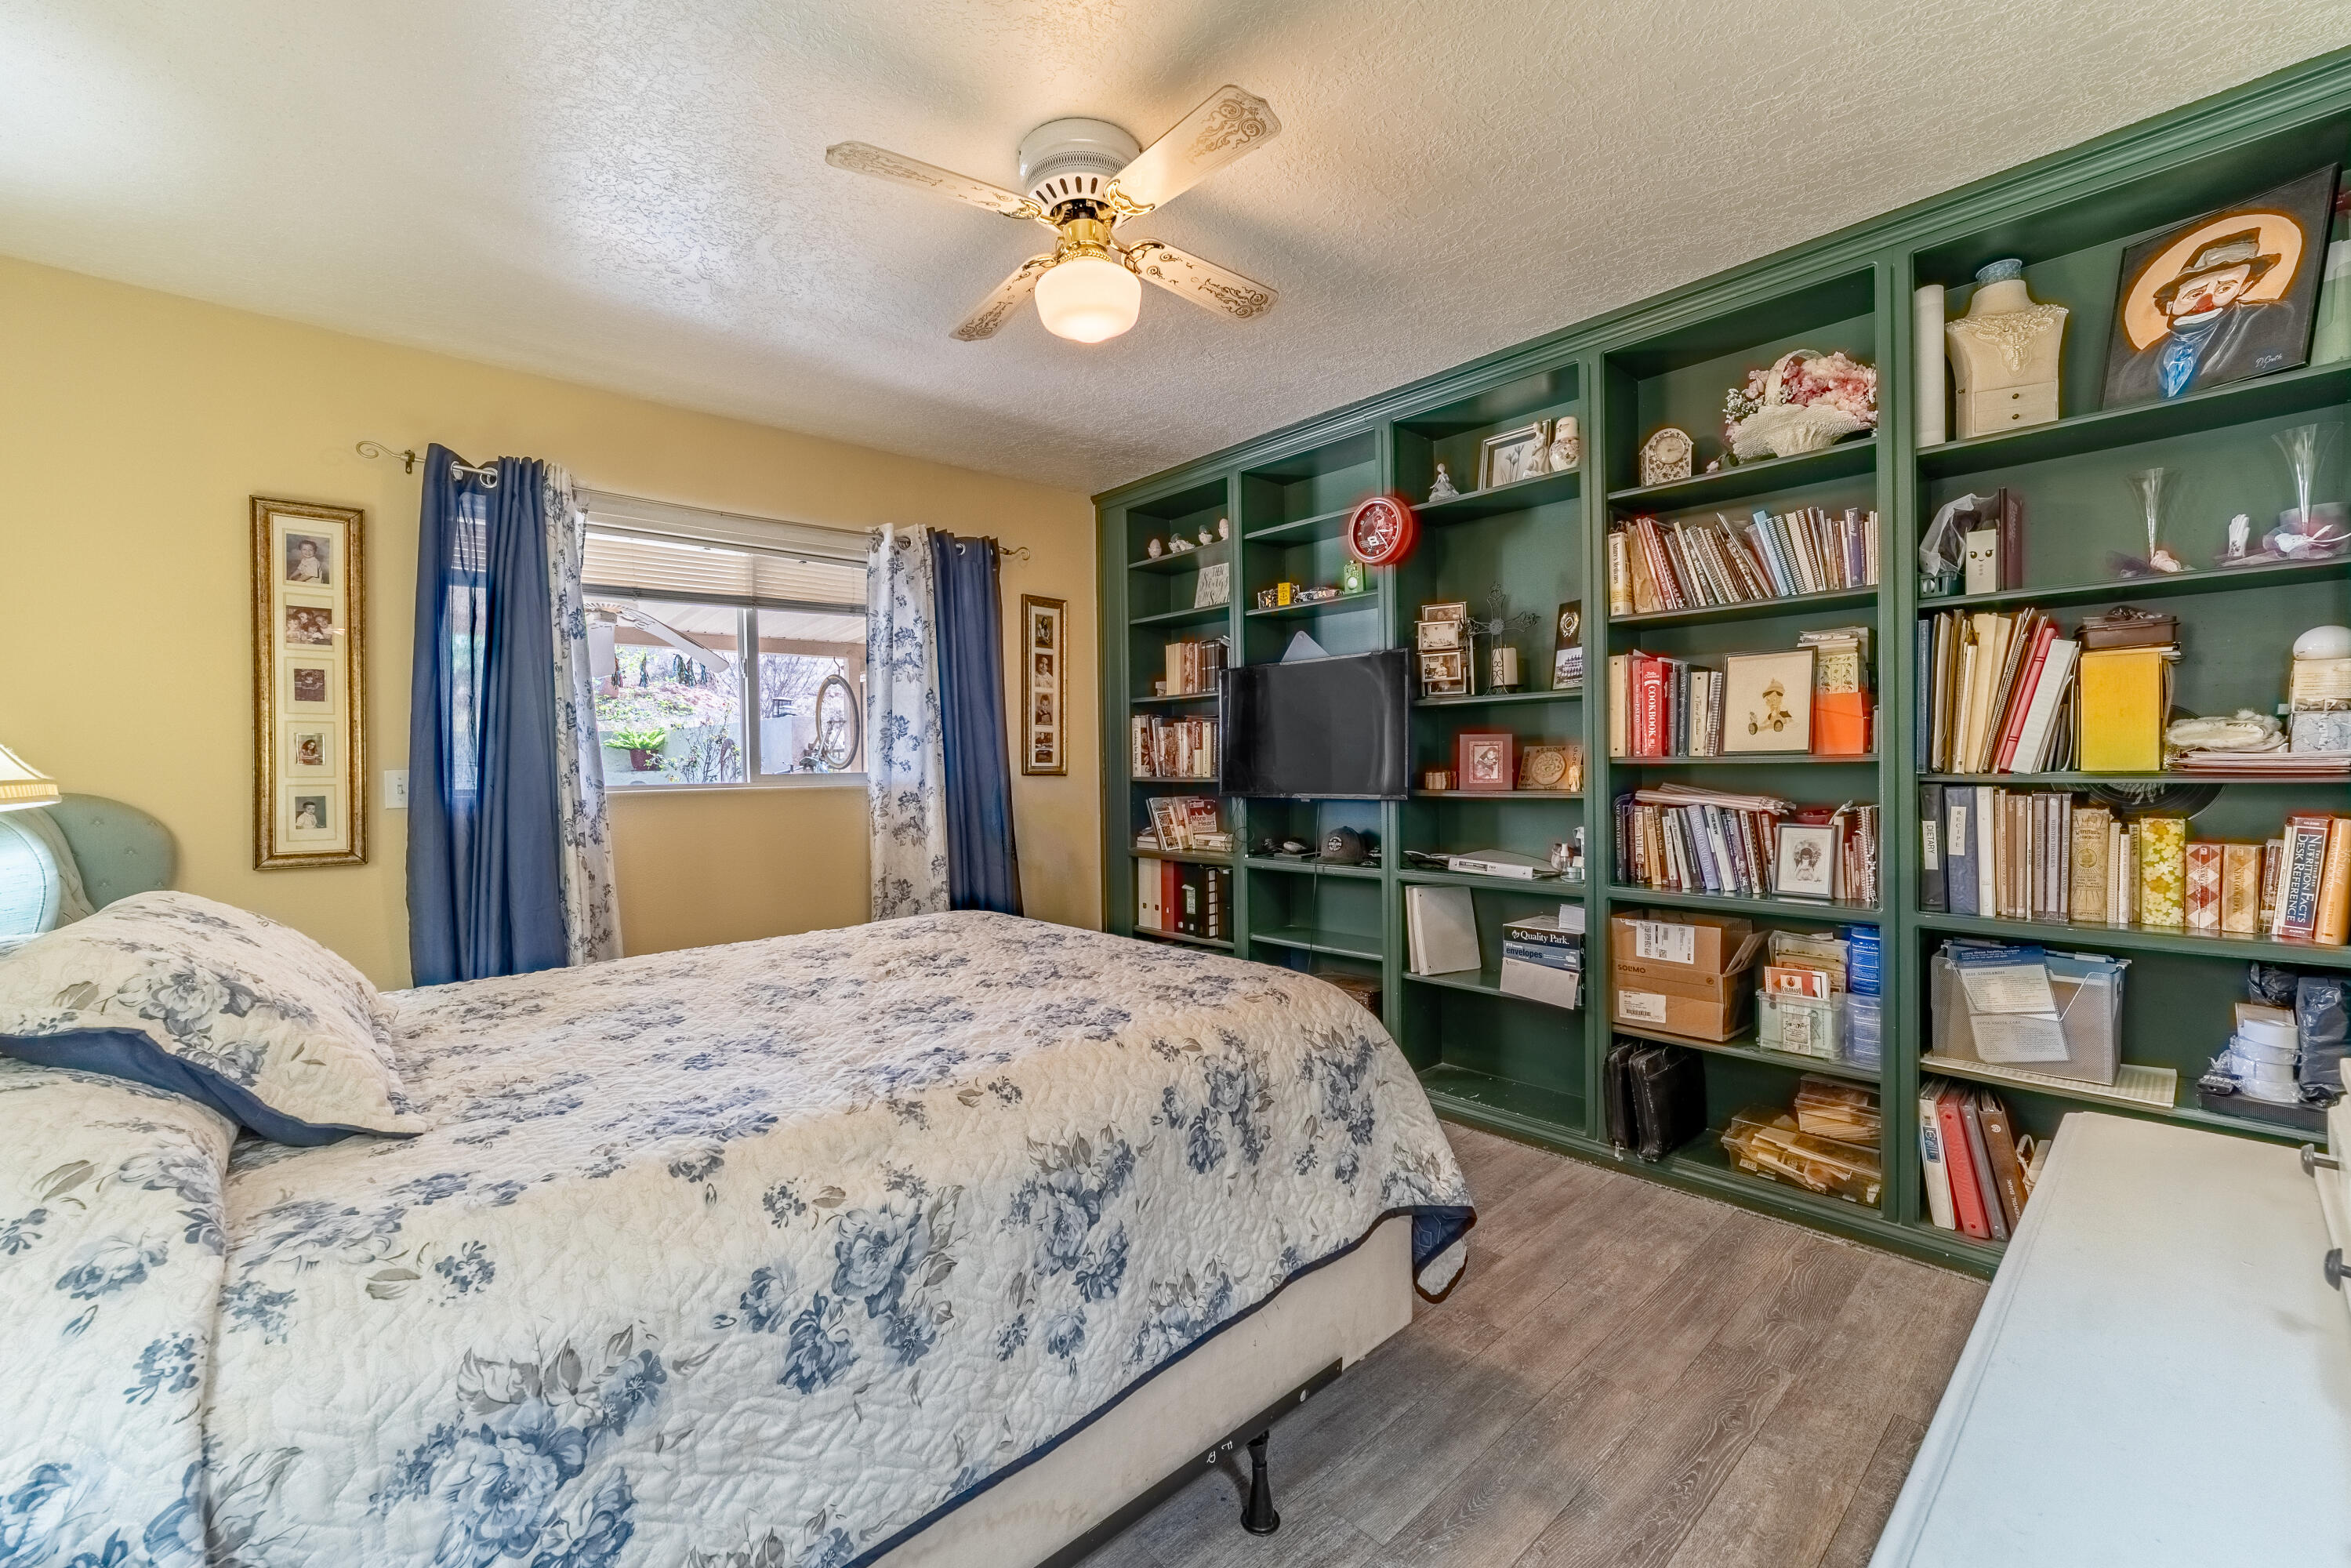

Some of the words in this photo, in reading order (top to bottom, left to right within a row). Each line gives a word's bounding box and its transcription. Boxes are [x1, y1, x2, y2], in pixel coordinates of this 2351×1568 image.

[1367, 535, 1380, 546] 8
[1648, 685, 1656, 737] COOKBOOK
[2295, 833, 2309, 860] DESK
[2302, 834, 2323, 891] NUTRITION
[2287, 863, 2305, 921] REFERENCE
[2298, 893, 2315, 923] FACTS
[1521, 931, 1548, 943] Quality
[1506, 947, 1543, 959] envelopes
[1617, 964, 1646, 974] SOLIMO
[1781, 985, 1801, 995] COLORADO
[2007, 1179, 2015, 1195] BANK
[2011, 1196, 2021, 1220] NENTAL
